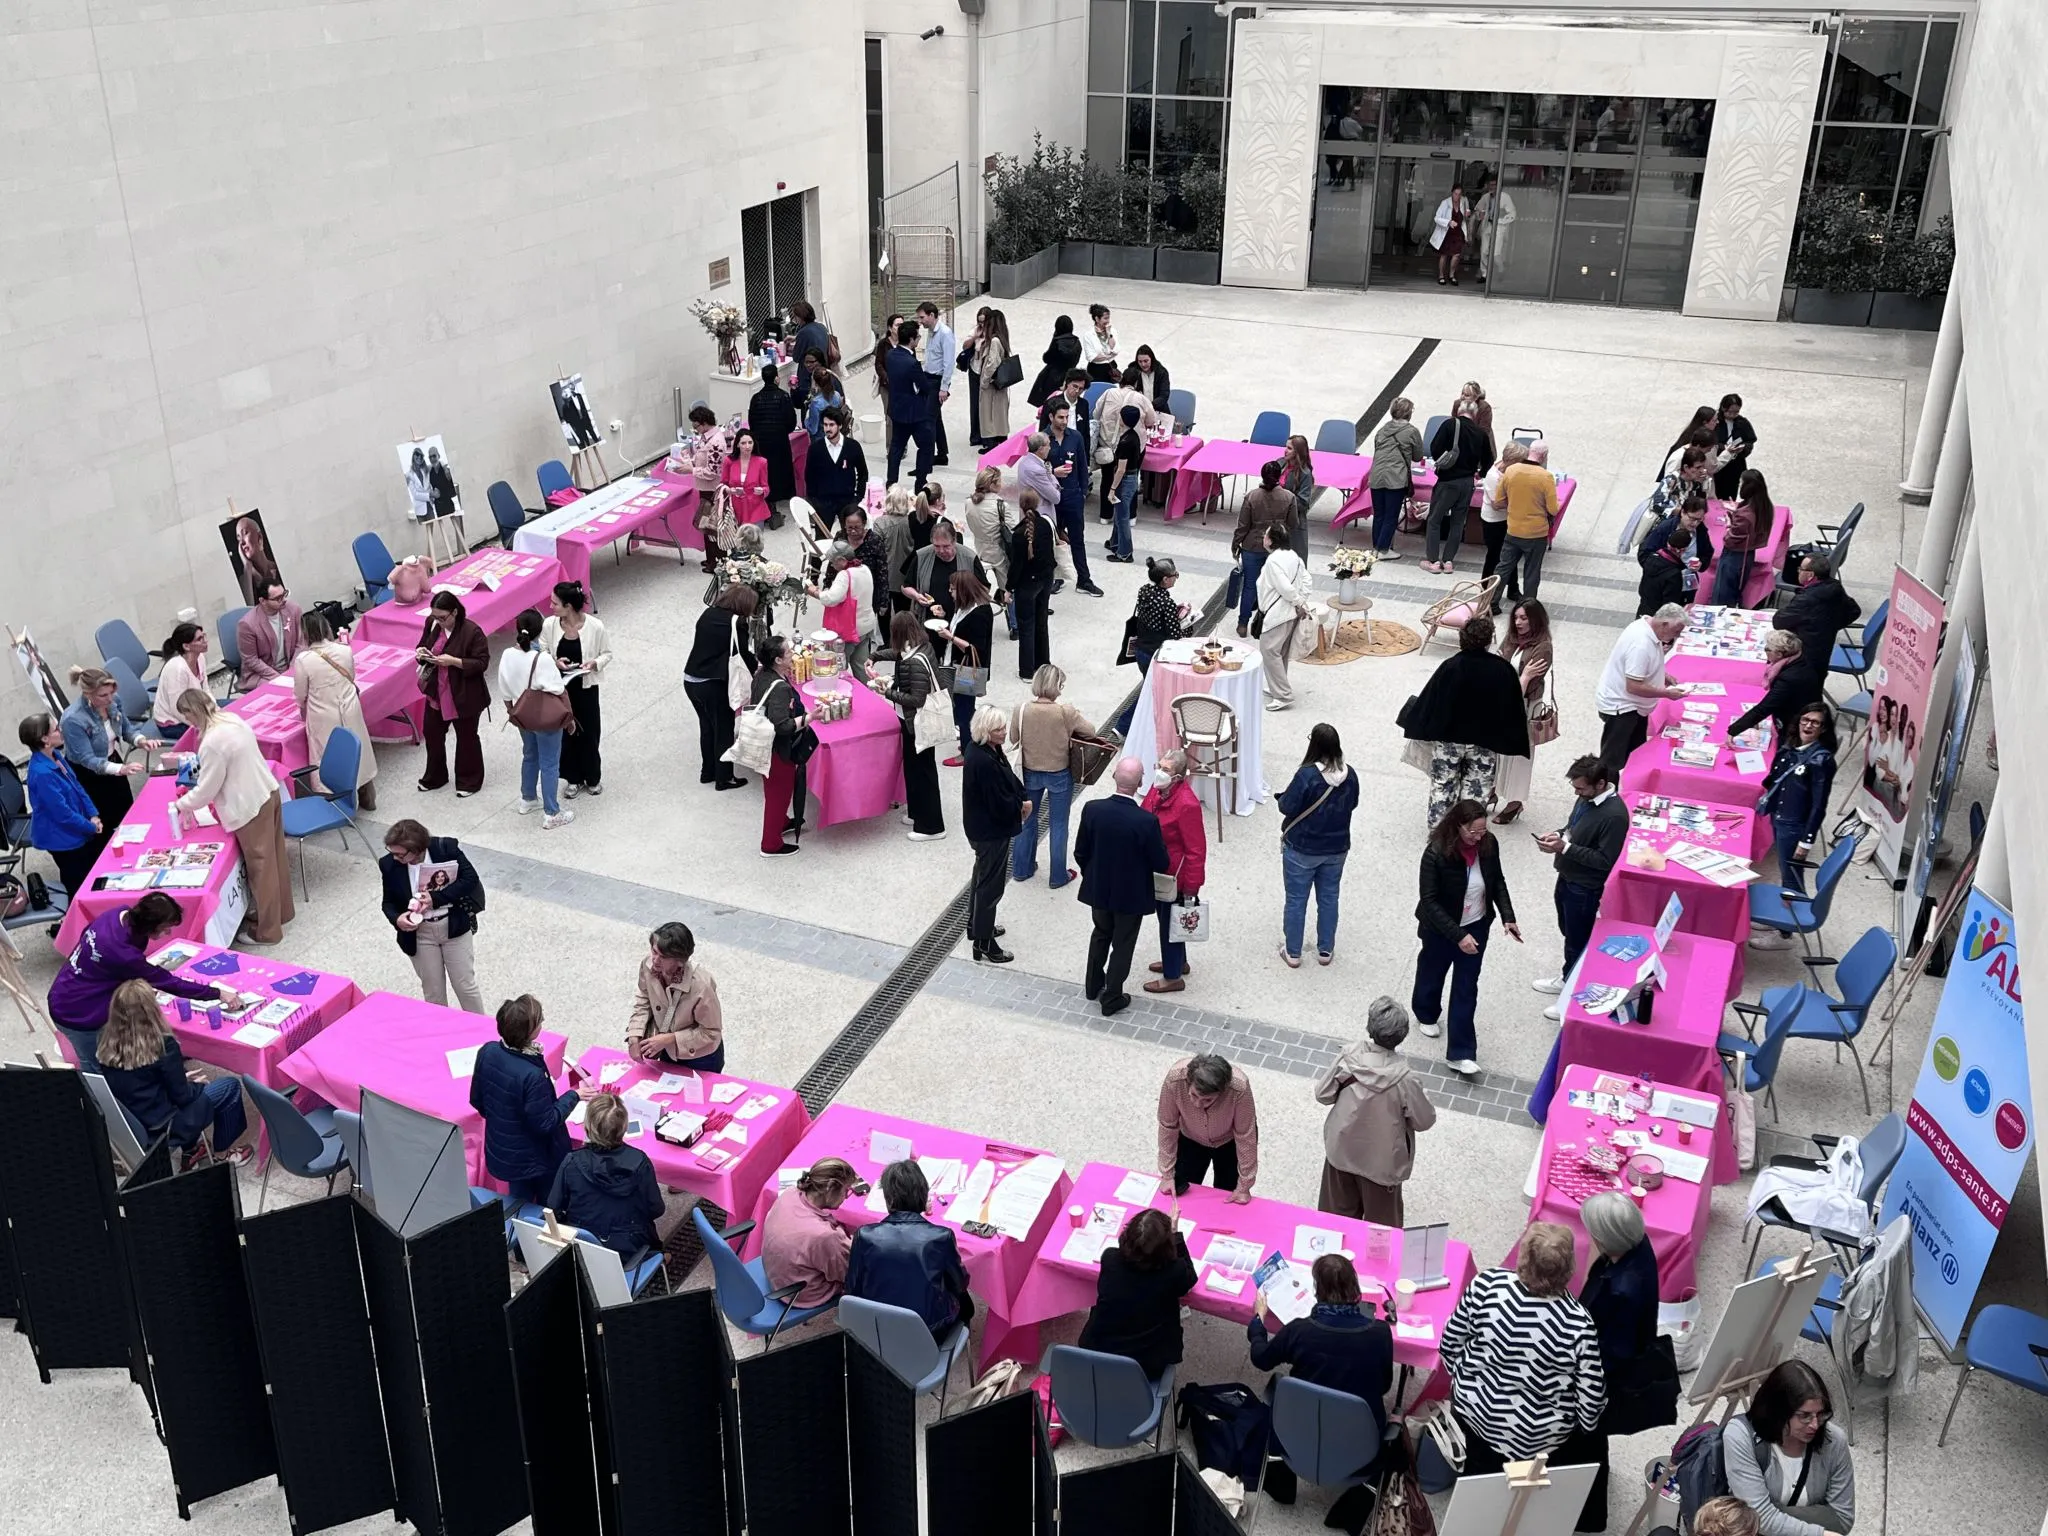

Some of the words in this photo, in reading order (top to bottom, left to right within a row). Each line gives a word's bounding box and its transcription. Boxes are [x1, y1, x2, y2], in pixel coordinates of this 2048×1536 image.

[1910, 1106, 2004, 1218] www.adps-sante.fr
[1899, 1196, 1942, 1262] Allianz
[1905, 1180, 1914, 1195] En
[1912, 1190, 1942, 1232] partenariat
[1940, 1228, 1955, 1249] avec
